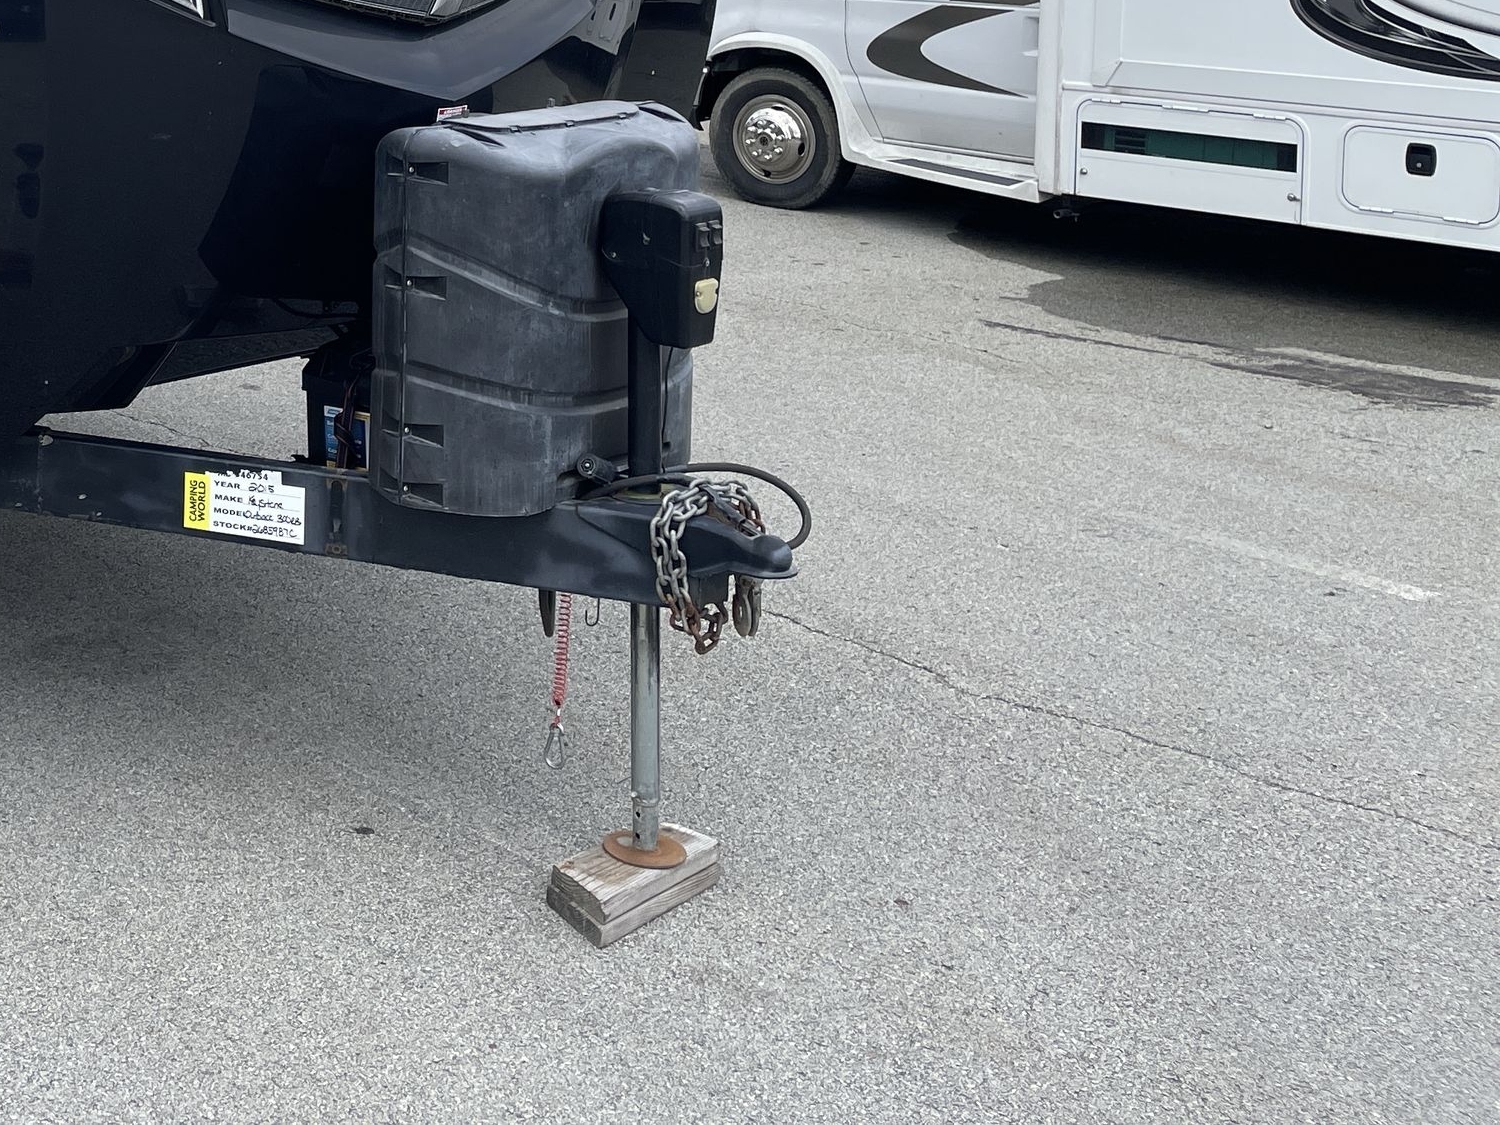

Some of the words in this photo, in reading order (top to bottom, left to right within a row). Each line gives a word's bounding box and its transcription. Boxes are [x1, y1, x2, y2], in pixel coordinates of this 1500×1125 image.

[214, 480, 241, 490] YEAR
[189, 479, 198, 522] CAMPING
[197, 481, 206, 522] WORLD
[214, 493, 243, 504] MAKE
[213, 507, 245, 517] MODEL
